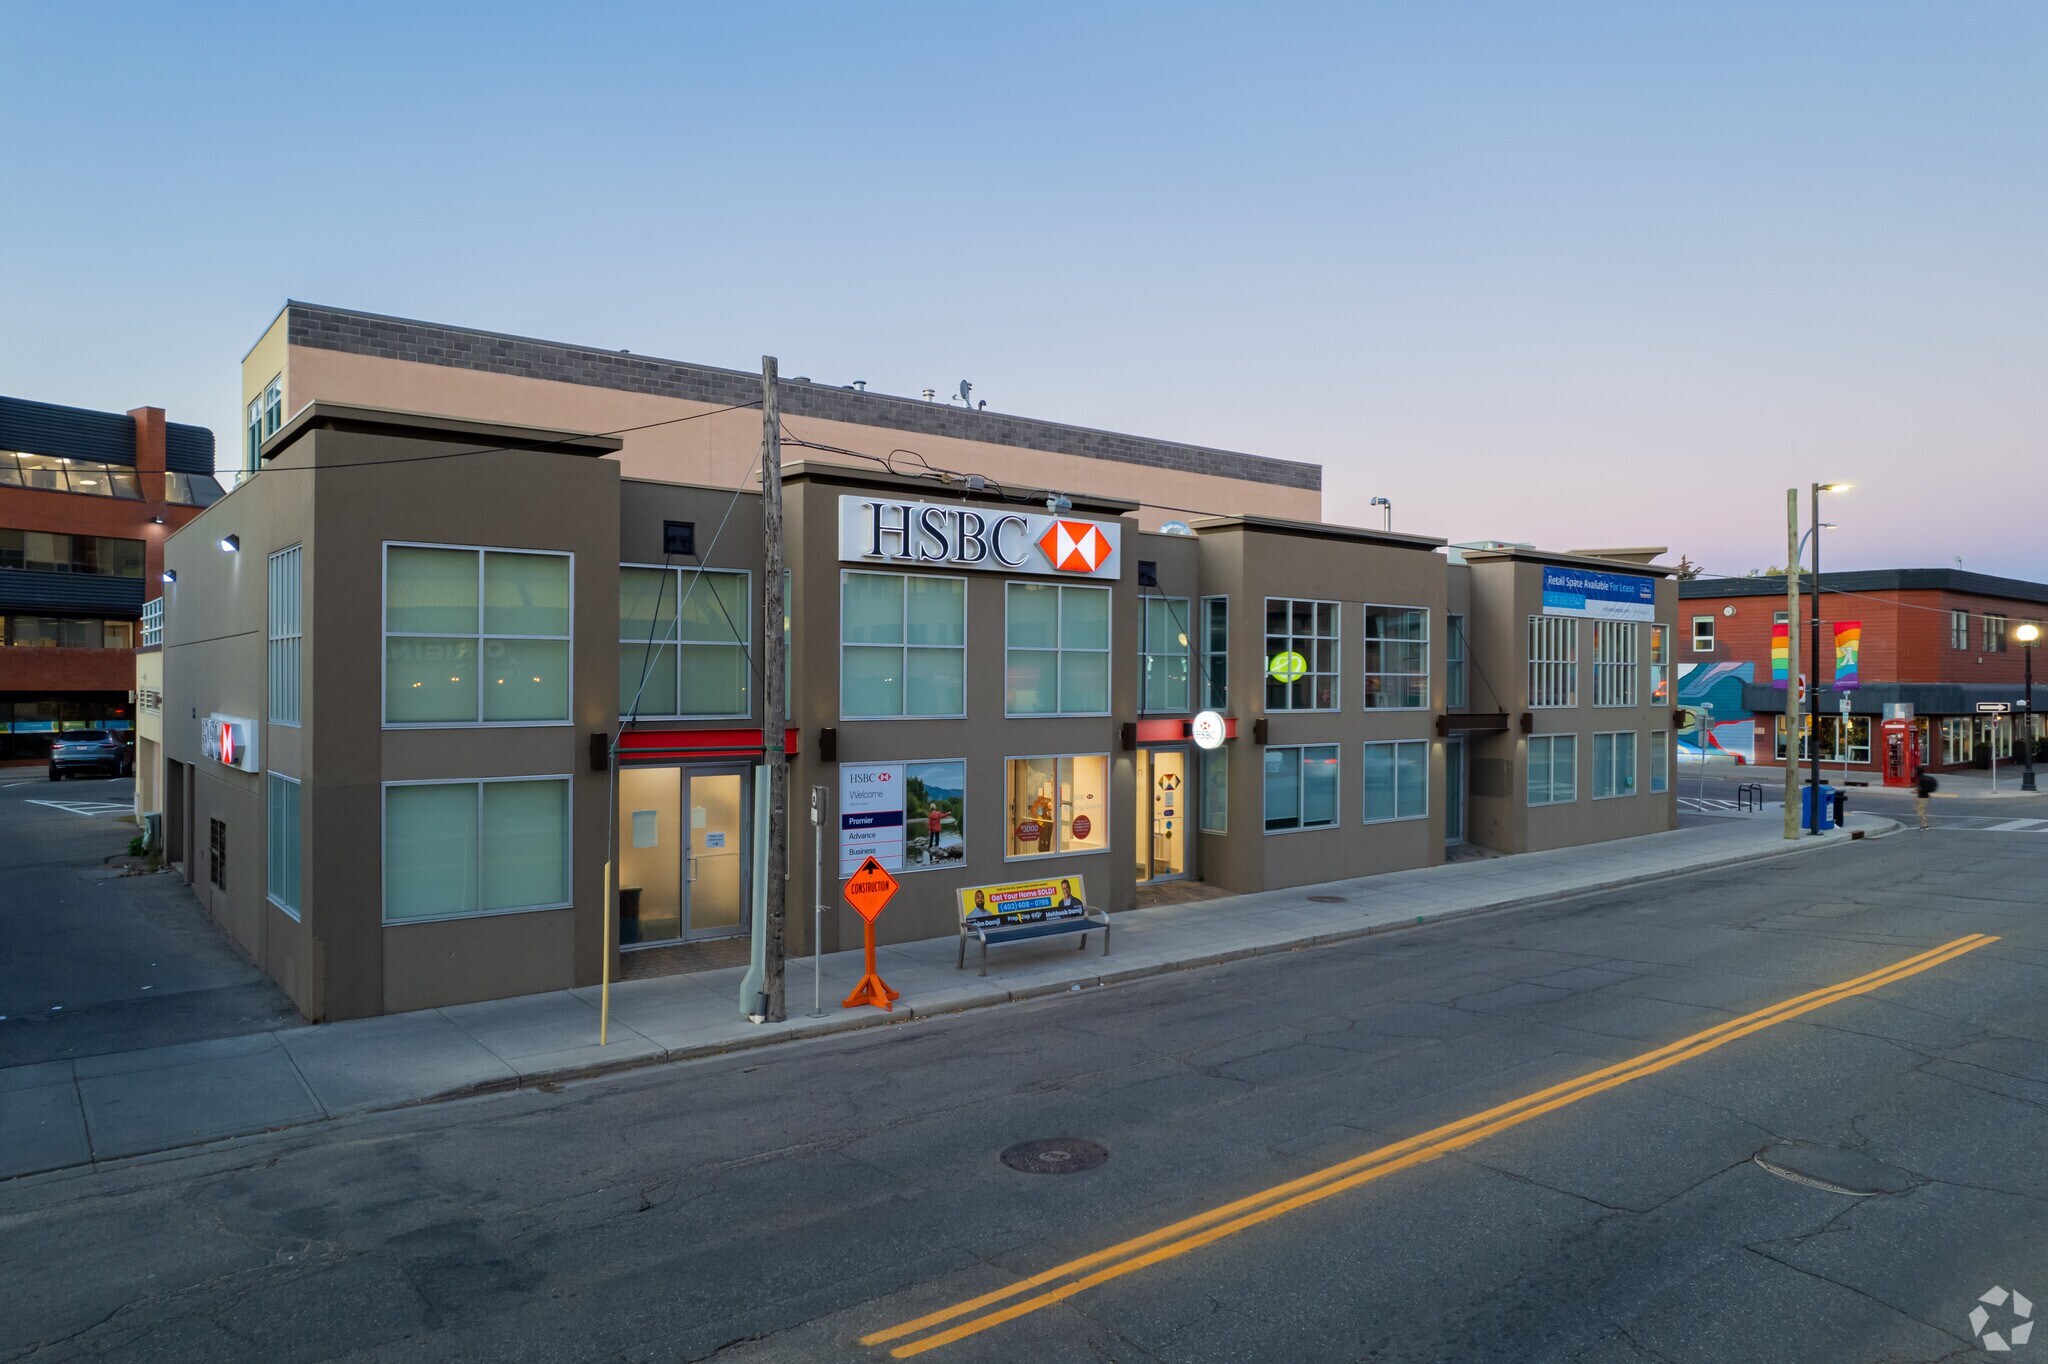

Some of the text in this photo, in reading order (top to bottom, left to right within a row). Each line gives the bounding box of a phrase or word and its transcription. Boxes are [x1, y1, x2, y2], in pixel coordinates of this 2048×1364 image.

[865, 501, 1029, 567] HSBC
[1548, 575, 1635, 593] Retail Space Available For Lease
[1195, 730, 1216, 740] HSBC
[850, 773, 876, 783] HSBC
[849, 790, 884, 799] Welcome
[849, 816, 874, 825] Premier
[849, 832, 876, 840] Advance
[849, 847, 876, 856] Business
[851, 881, 890, 895] CONSTRUCTION
[991, 887, 1055, 902] Get Your Home SOLD!
[1000, 902, 1018, 912] (403)
[1045, 908, 1068, 918] Mehboob
[1067, 906, 1083, 915] Damji
[985, 918, 1001, 927] Damji
